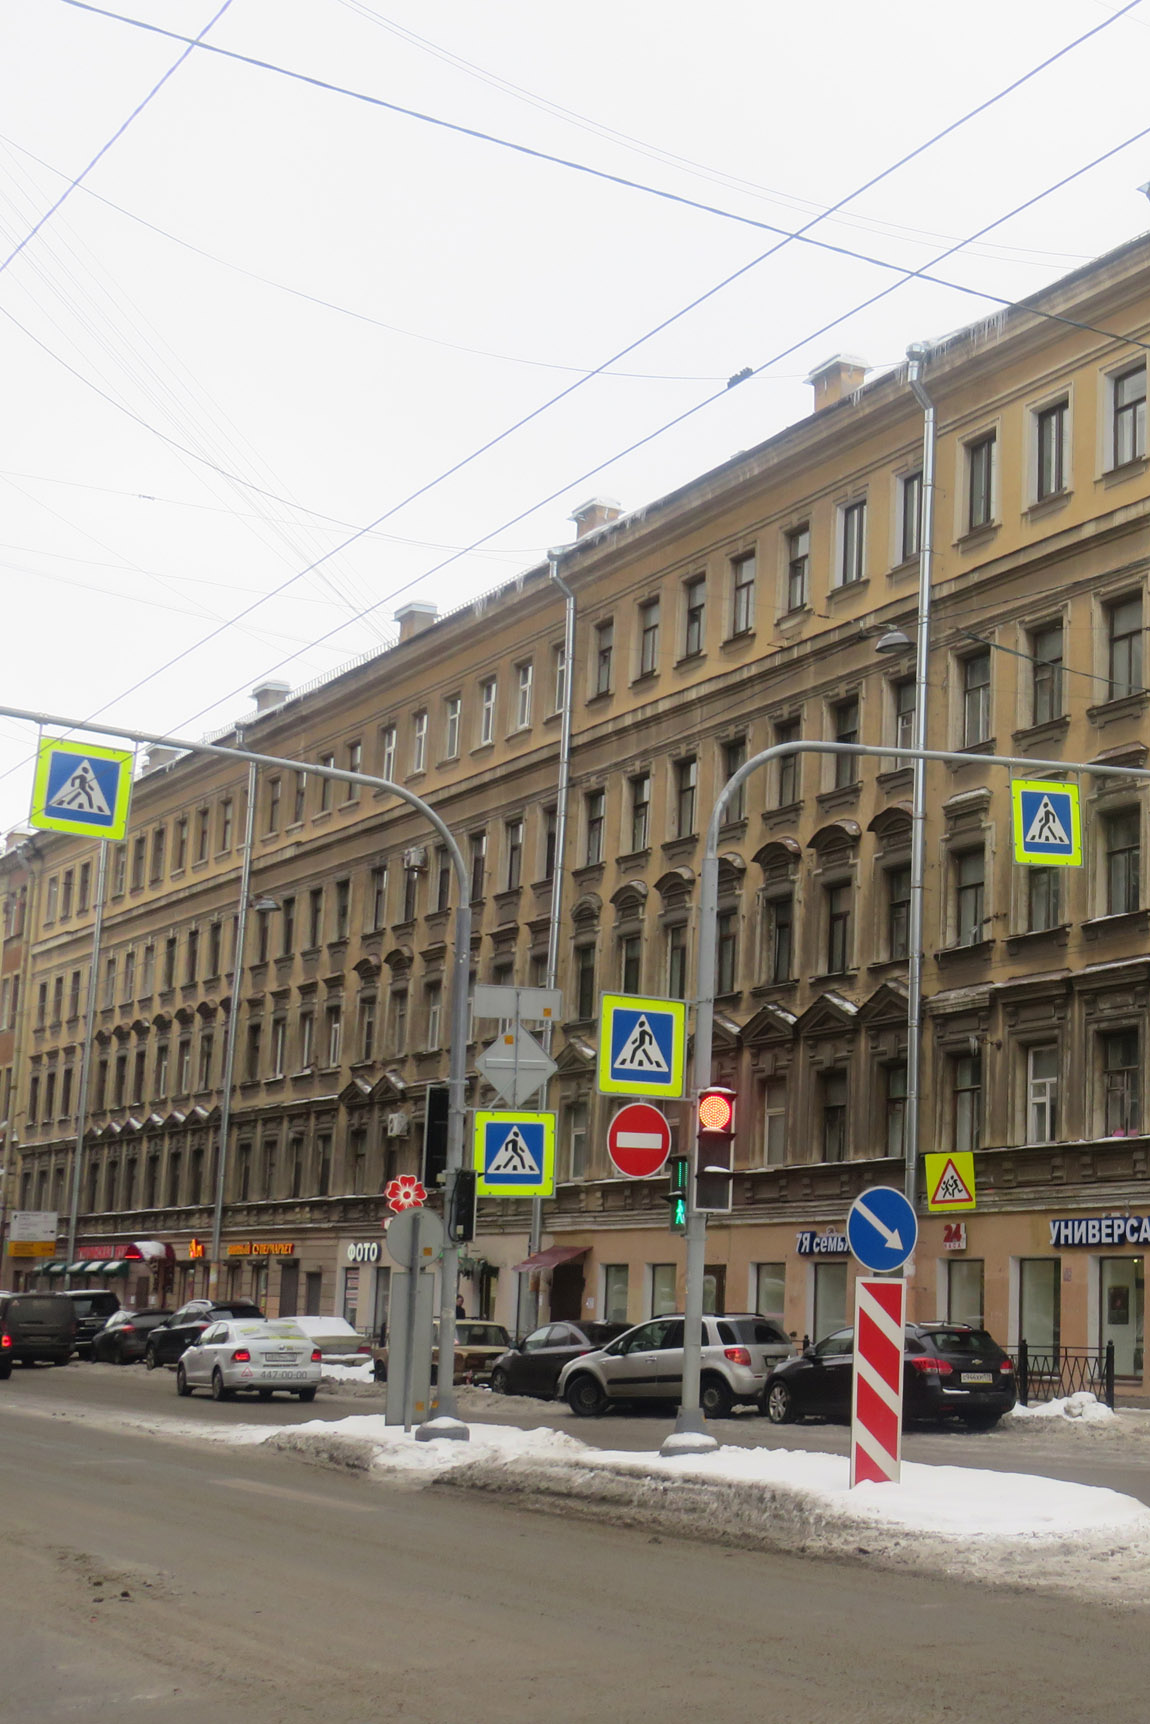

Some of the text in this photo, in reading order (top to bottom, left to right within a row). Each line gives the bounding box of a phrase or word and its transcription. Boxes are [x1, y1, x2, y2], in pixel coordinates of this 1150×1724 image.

[795, 1231, 810, 1253] 7Я
[944, 1223, 962, 1243] 24
[347, 1242, 379, 1262] ФОТО
[260, 1370, 308, 1379] 447-00-00
